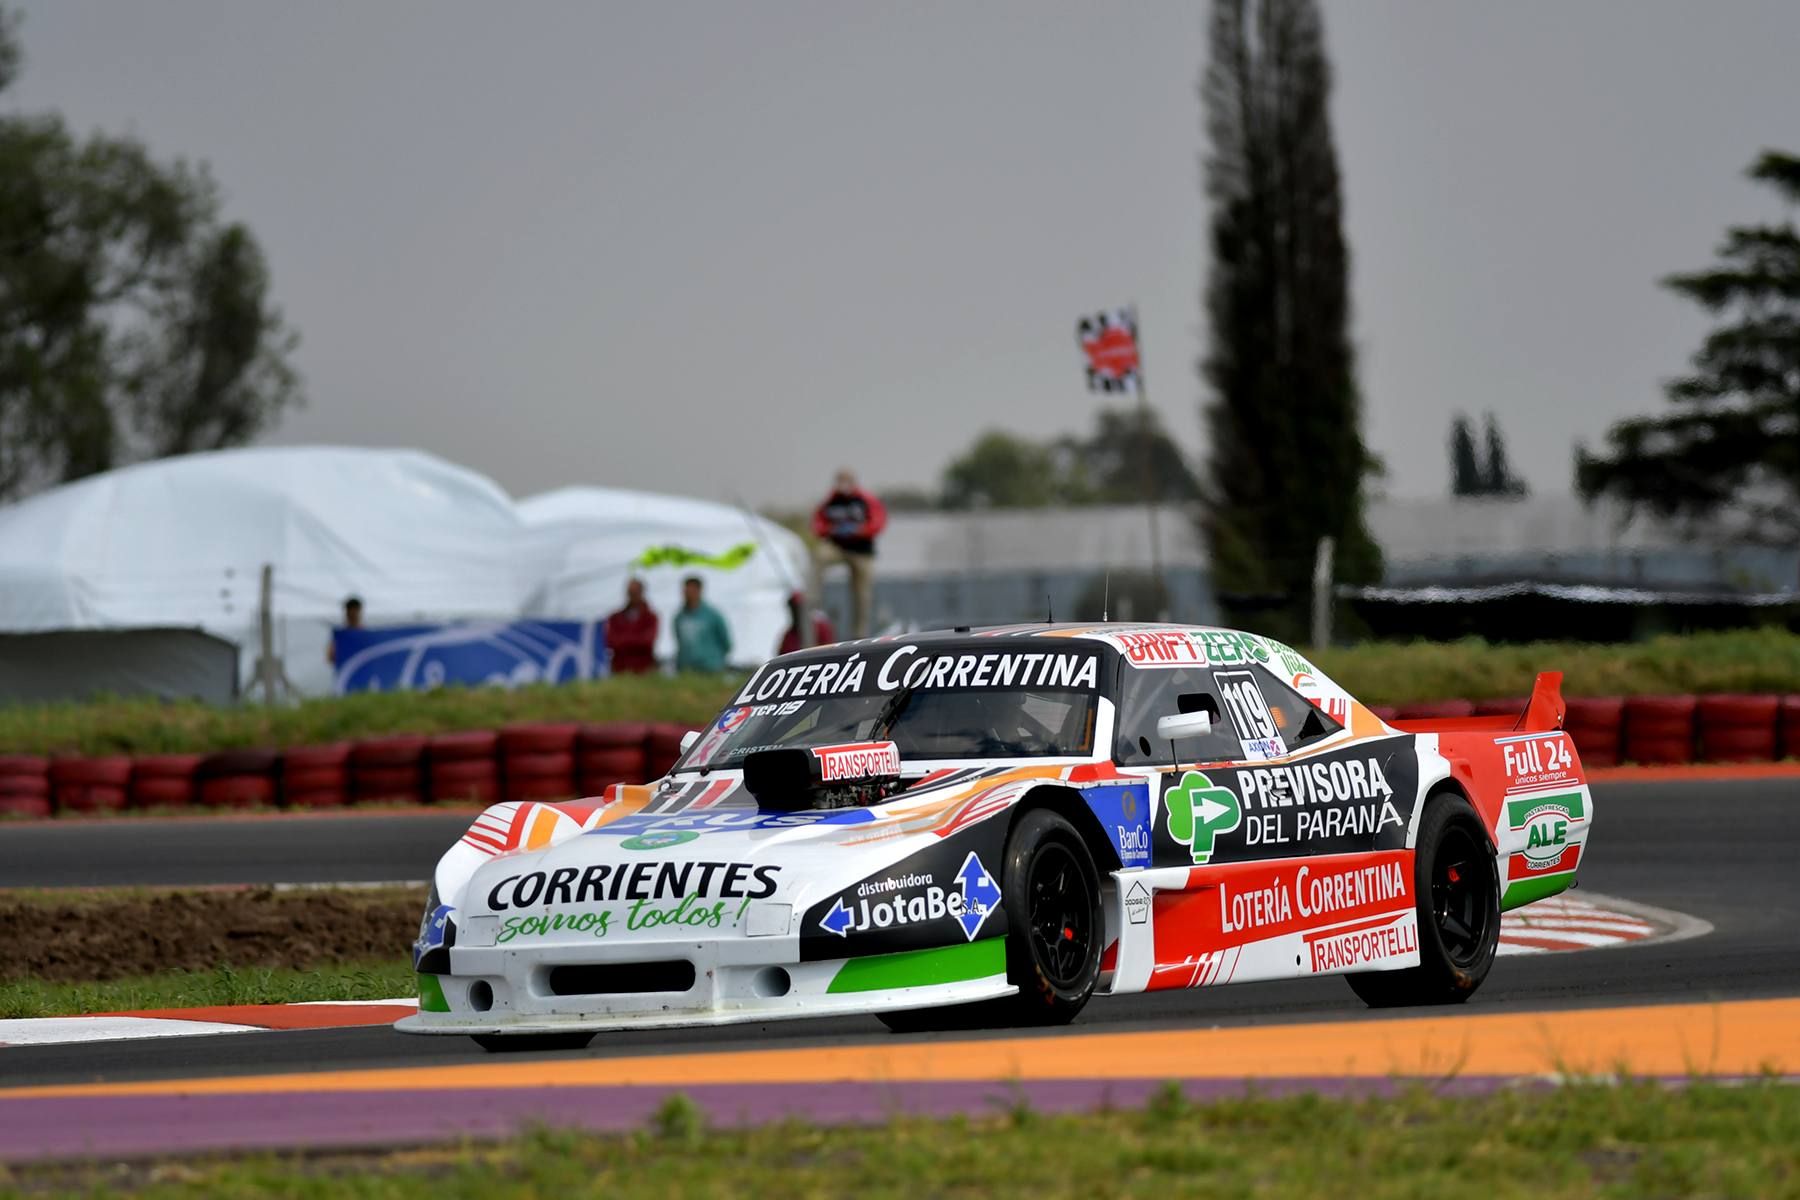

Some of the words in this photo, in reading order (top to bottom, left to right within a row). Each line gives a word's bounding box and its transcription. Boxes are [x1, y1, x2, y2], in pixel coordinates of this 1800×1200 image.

[735, 653, 866, 704] LOTERÍA
[877, 645, 1097, 690] CORRENTINA
[750, 704, 778, 717] TCP
[1222, 680, 1275, 739] 119
[1504, 740, 1543, 777] Full
[1544, 740, 1572, 770] 24
[1237, 758, 1394, 809] PREVISORA
[1515, 775, 1537, 784] únicos
[1538, 772, 1567, 781] siempre
[1246, 814, 1289, 846] DEL
[1296, 794, 1403, 841] PARANÁ
[1525, 805, 1544, 820] PASTAS
[1117, 824, 1148, 849] BanCo
[1527, 821, 1567, 849] ALE
[1527, 857, 1561, 869] CORRIENTES
[487, 862, 782, 911] CORRIENTES
[857, 873, 933, 896] distribuidora
[1220, 877, 1292, 934] LOTERÍA
[1296, 861, 1406, 918] CORRENTINA
[496, 910, 619, 943] somos
[856, 887, 962, 930] JotaBe
[1302, 912, 1417, 972] TRANSPORTELLI
